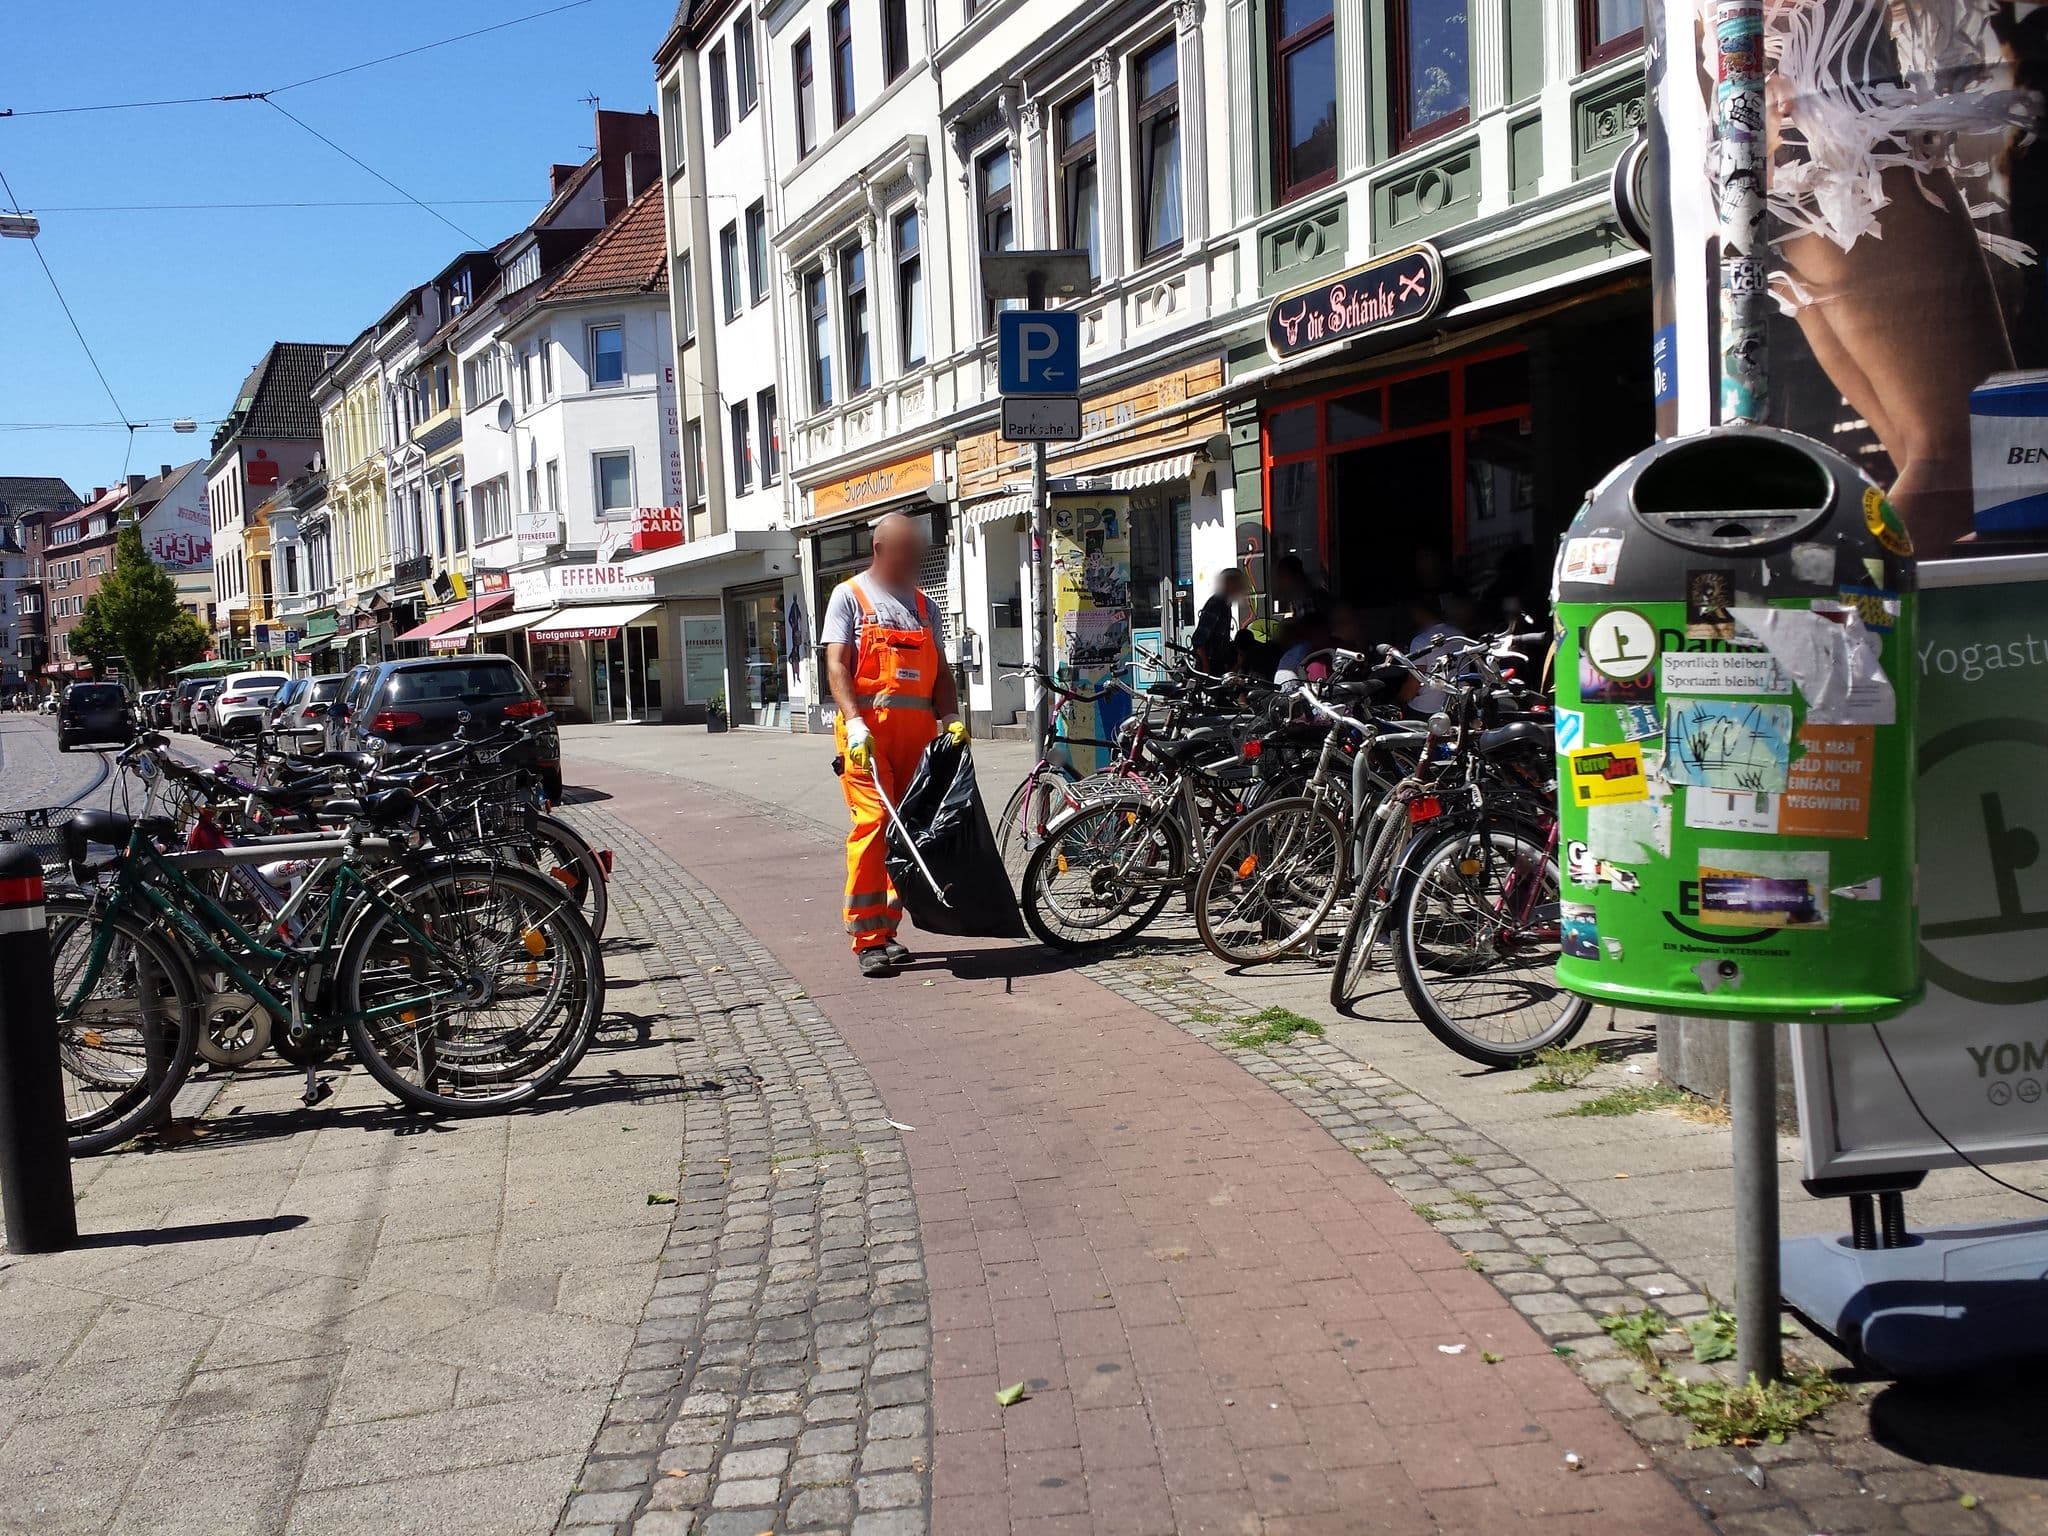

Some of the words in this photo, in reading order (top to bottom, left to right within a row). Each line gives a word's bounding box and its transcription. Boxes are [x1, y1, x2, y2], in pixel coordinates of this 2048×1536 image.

[1308, 310, 1325, 341] die
[1328, 281, 1396, 333] Schänke
[1018, 323, 1060, 383] P
[844, 470, 894, 502] SuppKultur
[641, 519, 683, 532] CARD
[561, 566, 655, 586] EFFENBE
[536, 631, 585, 641] Brotgenuss
[1664, 657, 1719, 669] Sportlich
[1722, 657, 1768, 669] bleiben
[1667, 675, 1721, 688] Sportamt
[1802, 740, 1822, 753] EIL
[1824, 761, 1863, 775] NICHT
[1788, 777, 1840, 792] EINFACH
[1787, 795, 1861, 812] WEGWIRFT!
